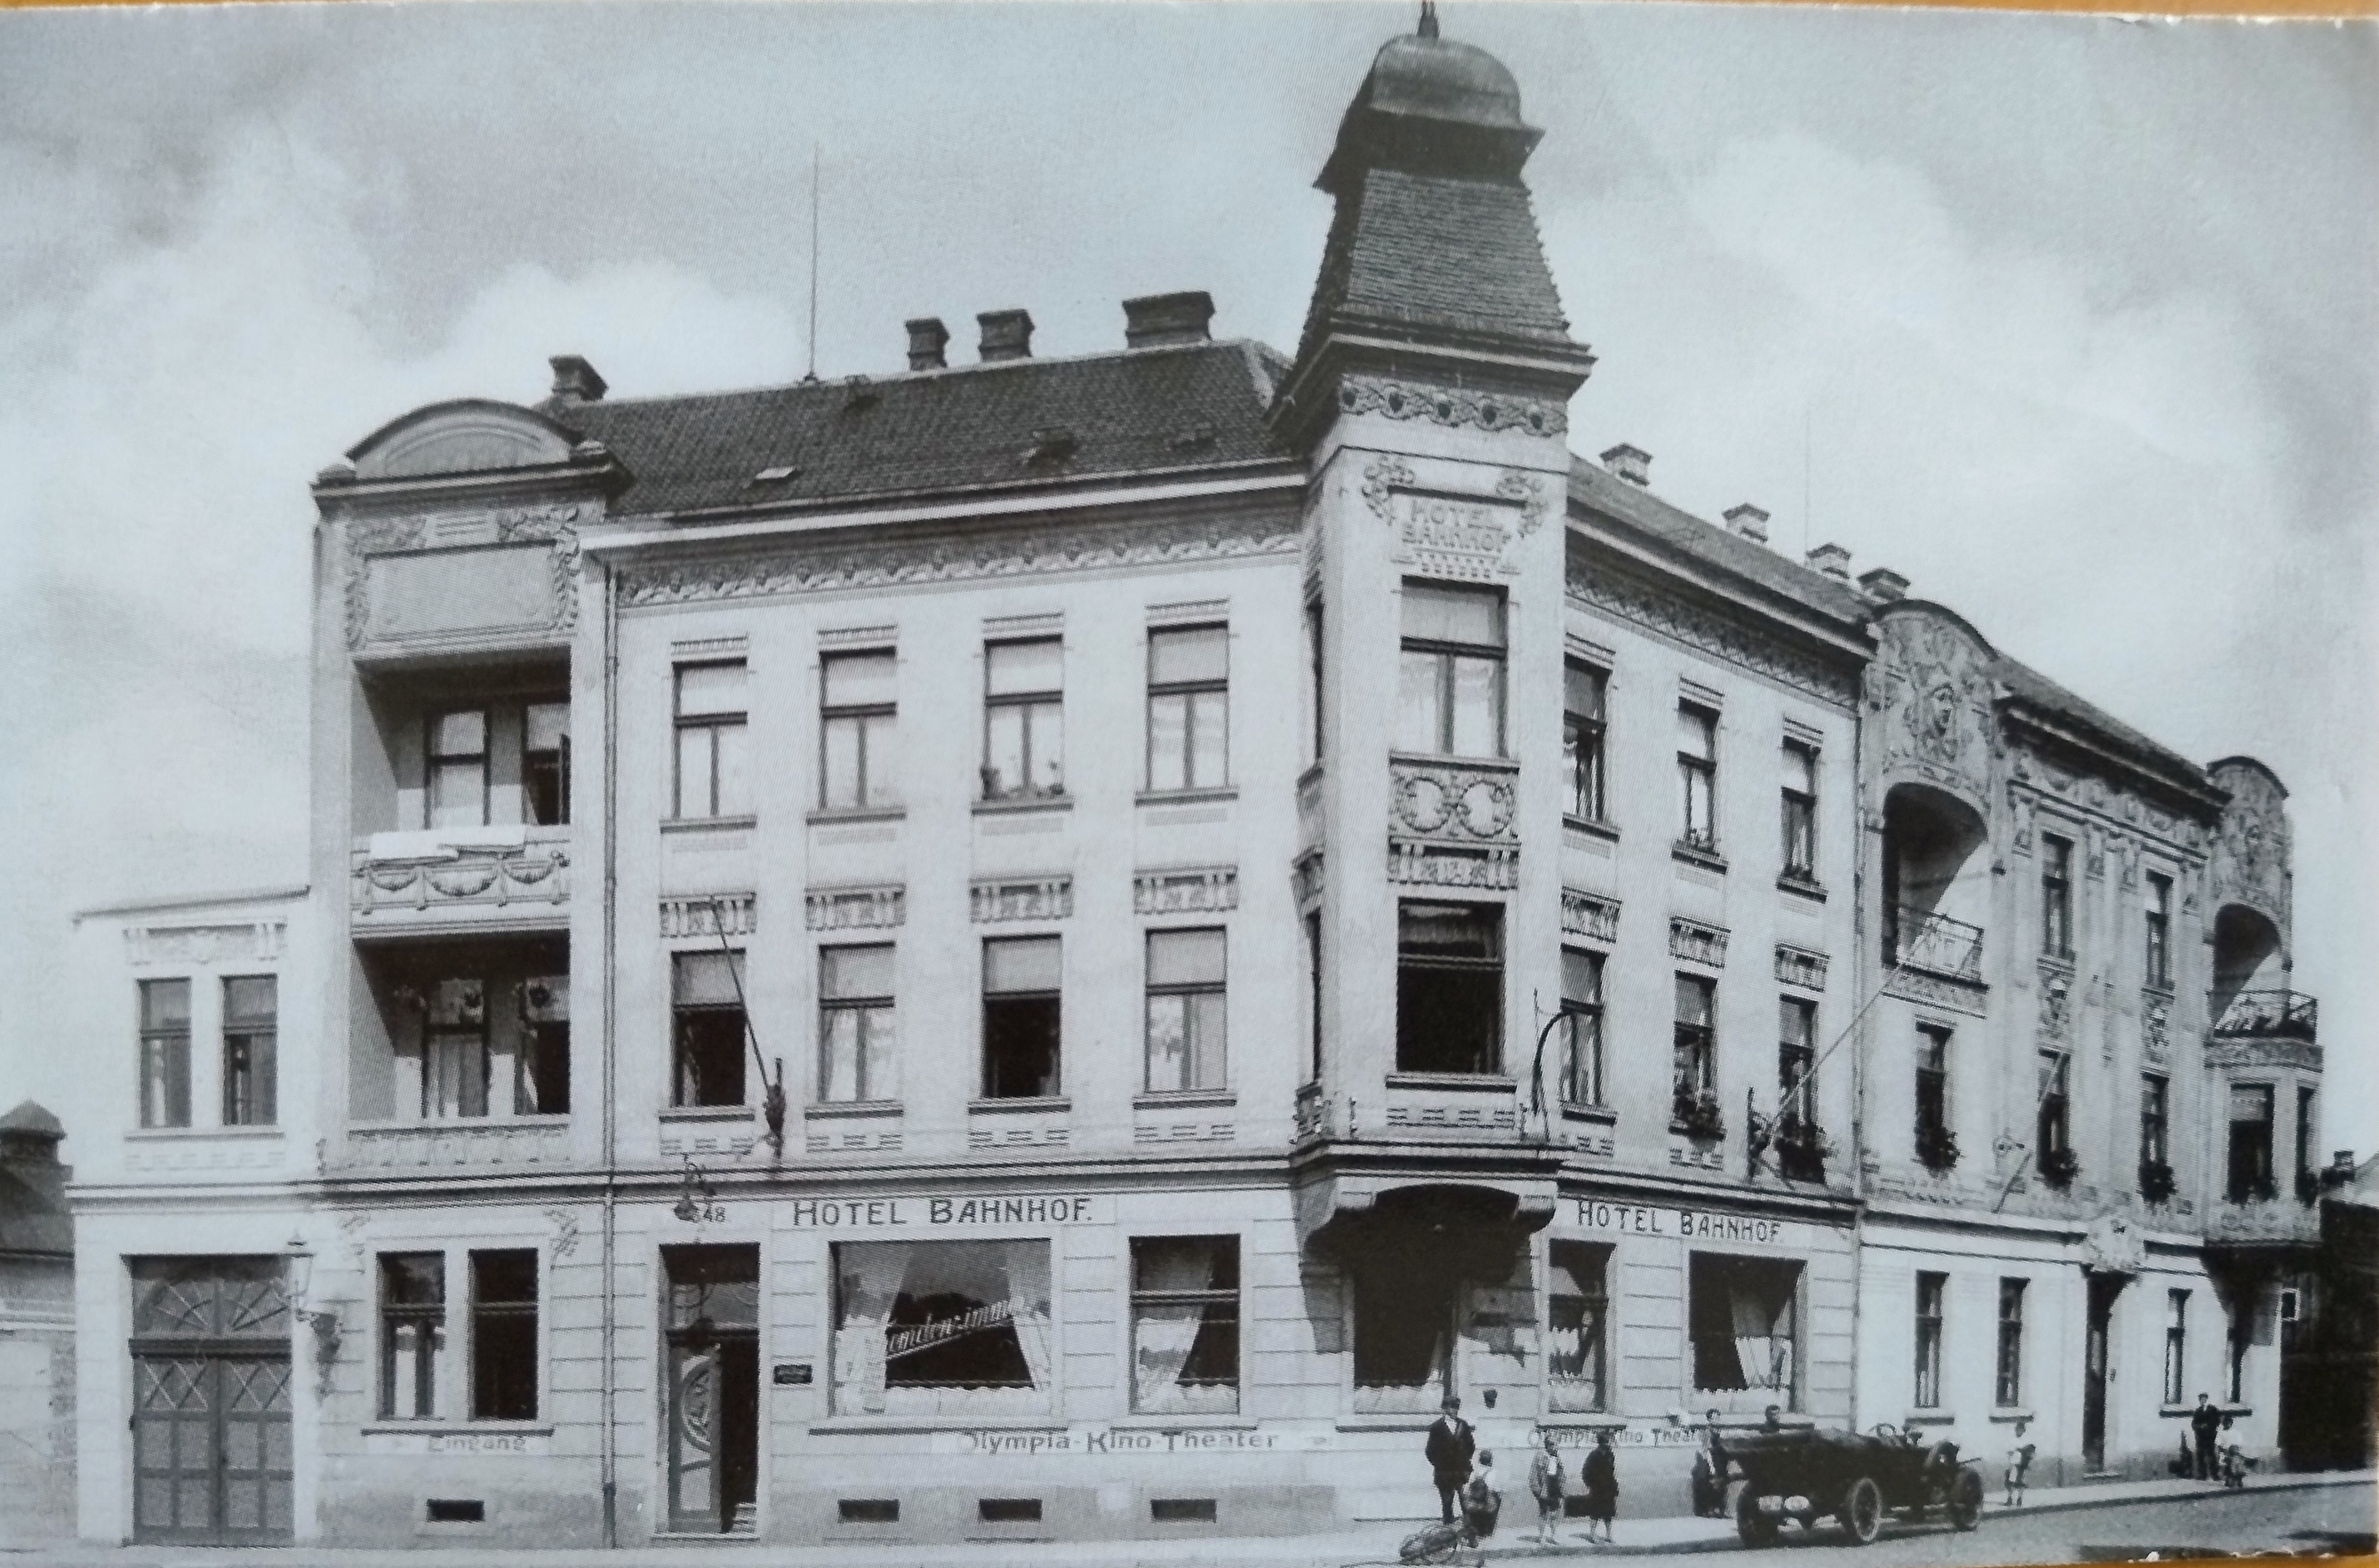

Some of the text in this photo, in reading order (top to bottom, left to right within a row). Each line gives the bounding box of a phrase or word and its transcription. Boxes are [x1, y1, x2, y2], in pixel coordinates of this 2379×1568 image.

[793, 1200, 907, 1226] HOTEL
[1578, 1197, 1781, 1242] HOTEL BAHNHOF
